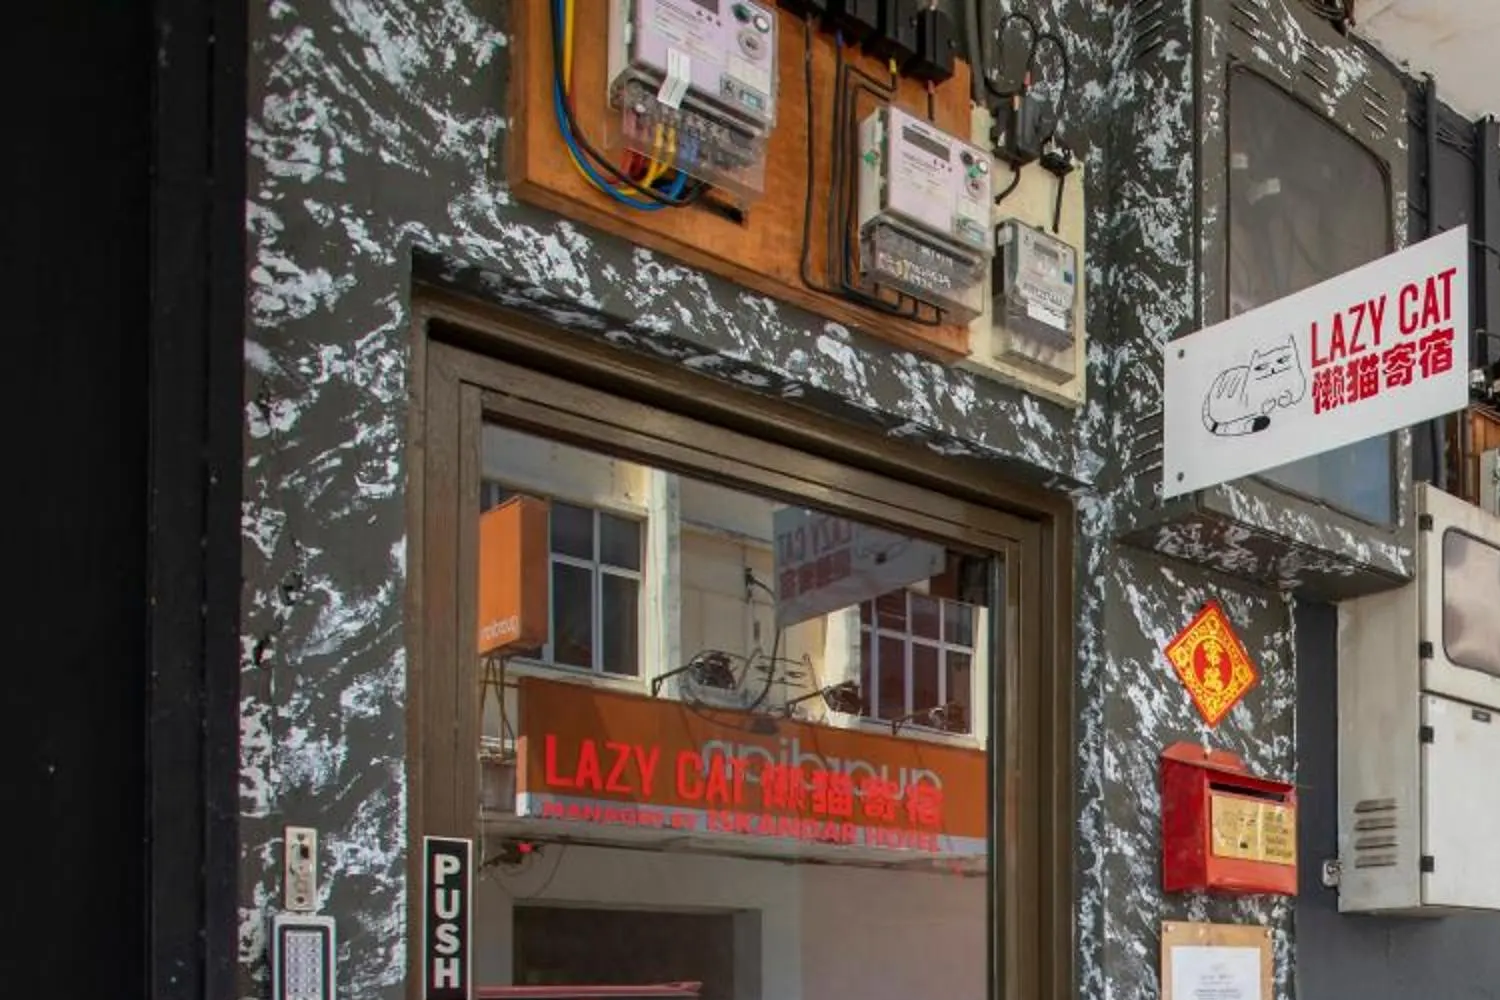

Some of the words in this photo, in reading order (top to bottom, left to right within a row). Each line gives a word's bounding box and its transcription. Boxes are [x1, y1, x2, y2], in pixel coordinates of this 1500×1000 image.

[1311, 296, 1387, 368] LAZY
[1399, 267, 1457, 334] CAT
[545, 733, 661, 796] LAZY
[676, 749, 747, 804] CAT
[432, 853, 461, 989] PUSH
